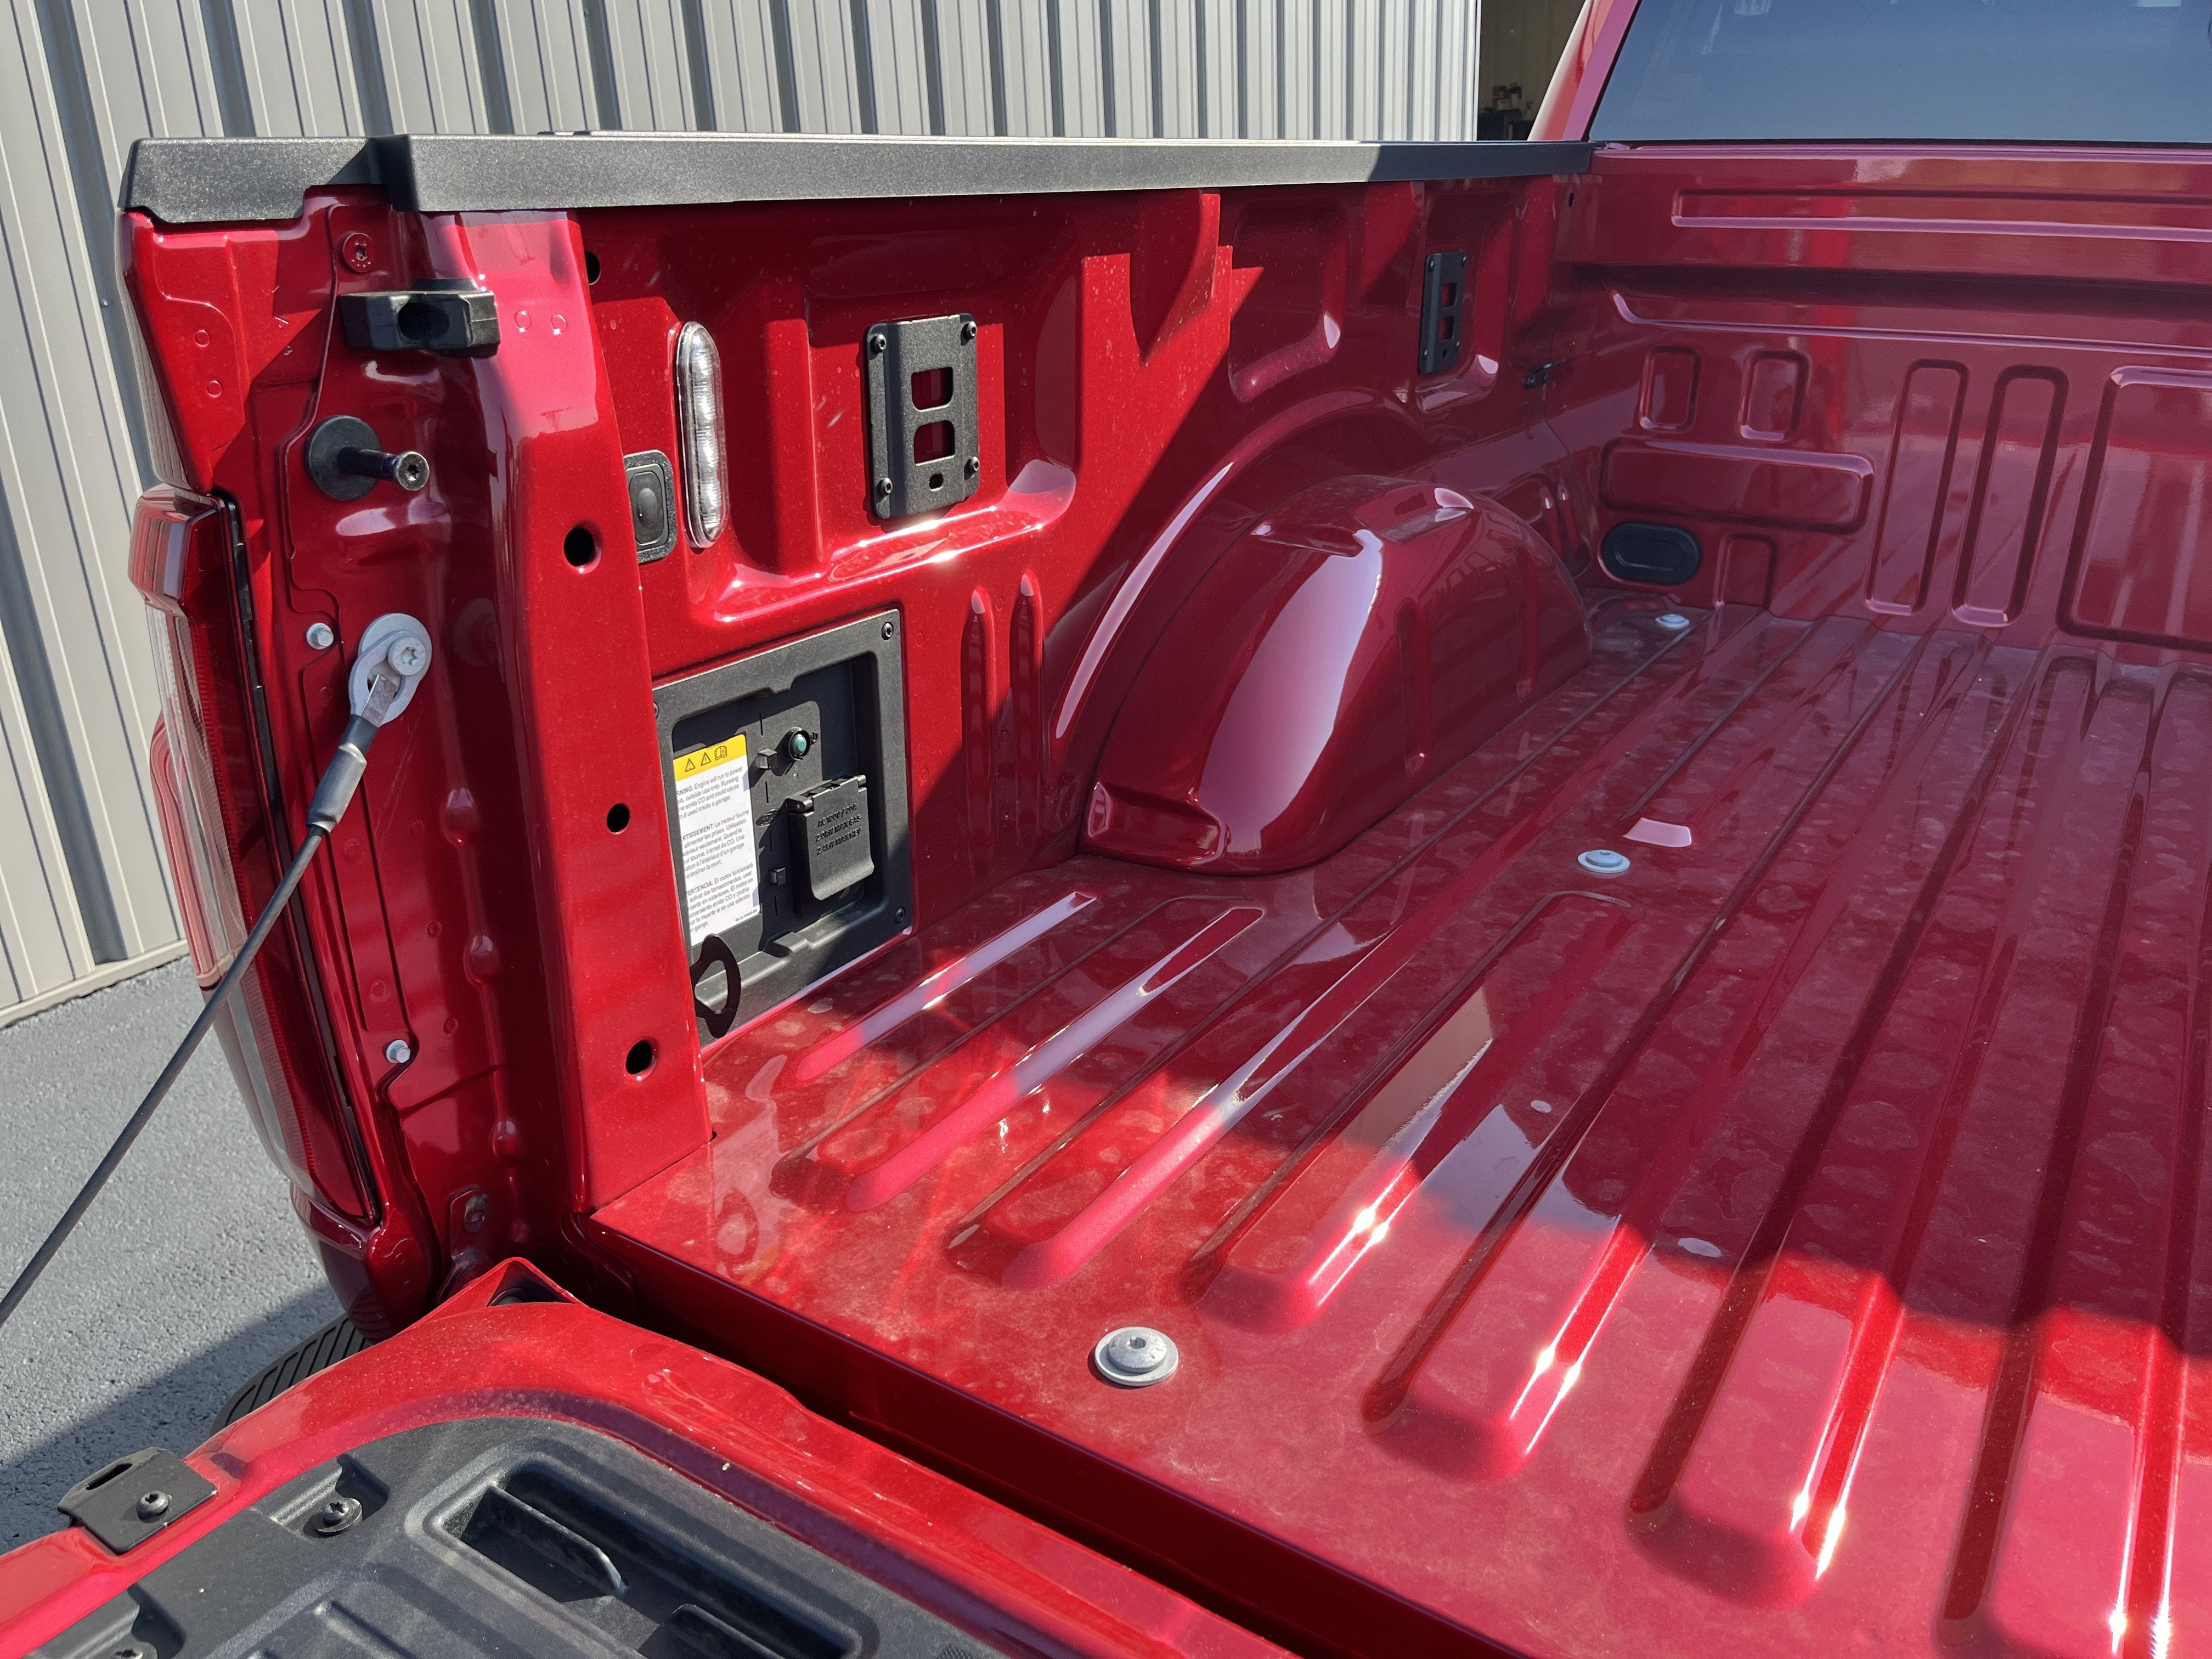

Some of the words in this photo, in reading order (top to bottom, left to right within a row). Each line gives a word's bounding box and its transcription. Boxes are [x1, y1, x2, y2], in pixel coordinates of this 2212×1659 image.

[686, 791, 702, 802] outside
[721, 776, 739, 787] Running
[694, 780, 709, 790] Engine
[730, 766, 743, 777] power
[685, 801, 697, 809] emits
[706, 793, 714, 801] and
[714, 788, 726, 798] could
[726, 784, 739, 793] cause
[687, 808, 698, 817] used
[698, 803, 711, 812] inside
[715, 795, 731, 806] garage.
[721, 815, 736, 825] moteur
[736, 810, 749, 819] tourne
[684, 836, 704, 849] alimenter
[726, 819, 747, 831] Utilisation
[723, 828, 738, 839] Quand
[699, 853, 720, 866] l'intérieur
[720, 849, 730, 857] d'un
[730, 843, 744, 854] garage
[709, 844, 721, 854] émet
[719, 872, 732, 882] motor
[732, 862, 753, 876] funcionará
[690, 893, 703, 903] activar
[743, 871, 752, 879] usar
[736, 881, 747, 889] motor
[701, 910, 716, 920] muerte
[735, 894, 751, 905] adentro
[713, 899, 725, 907] emite
[725, 894, 732, 902] CO
[736, 887, 749, 898] podría
